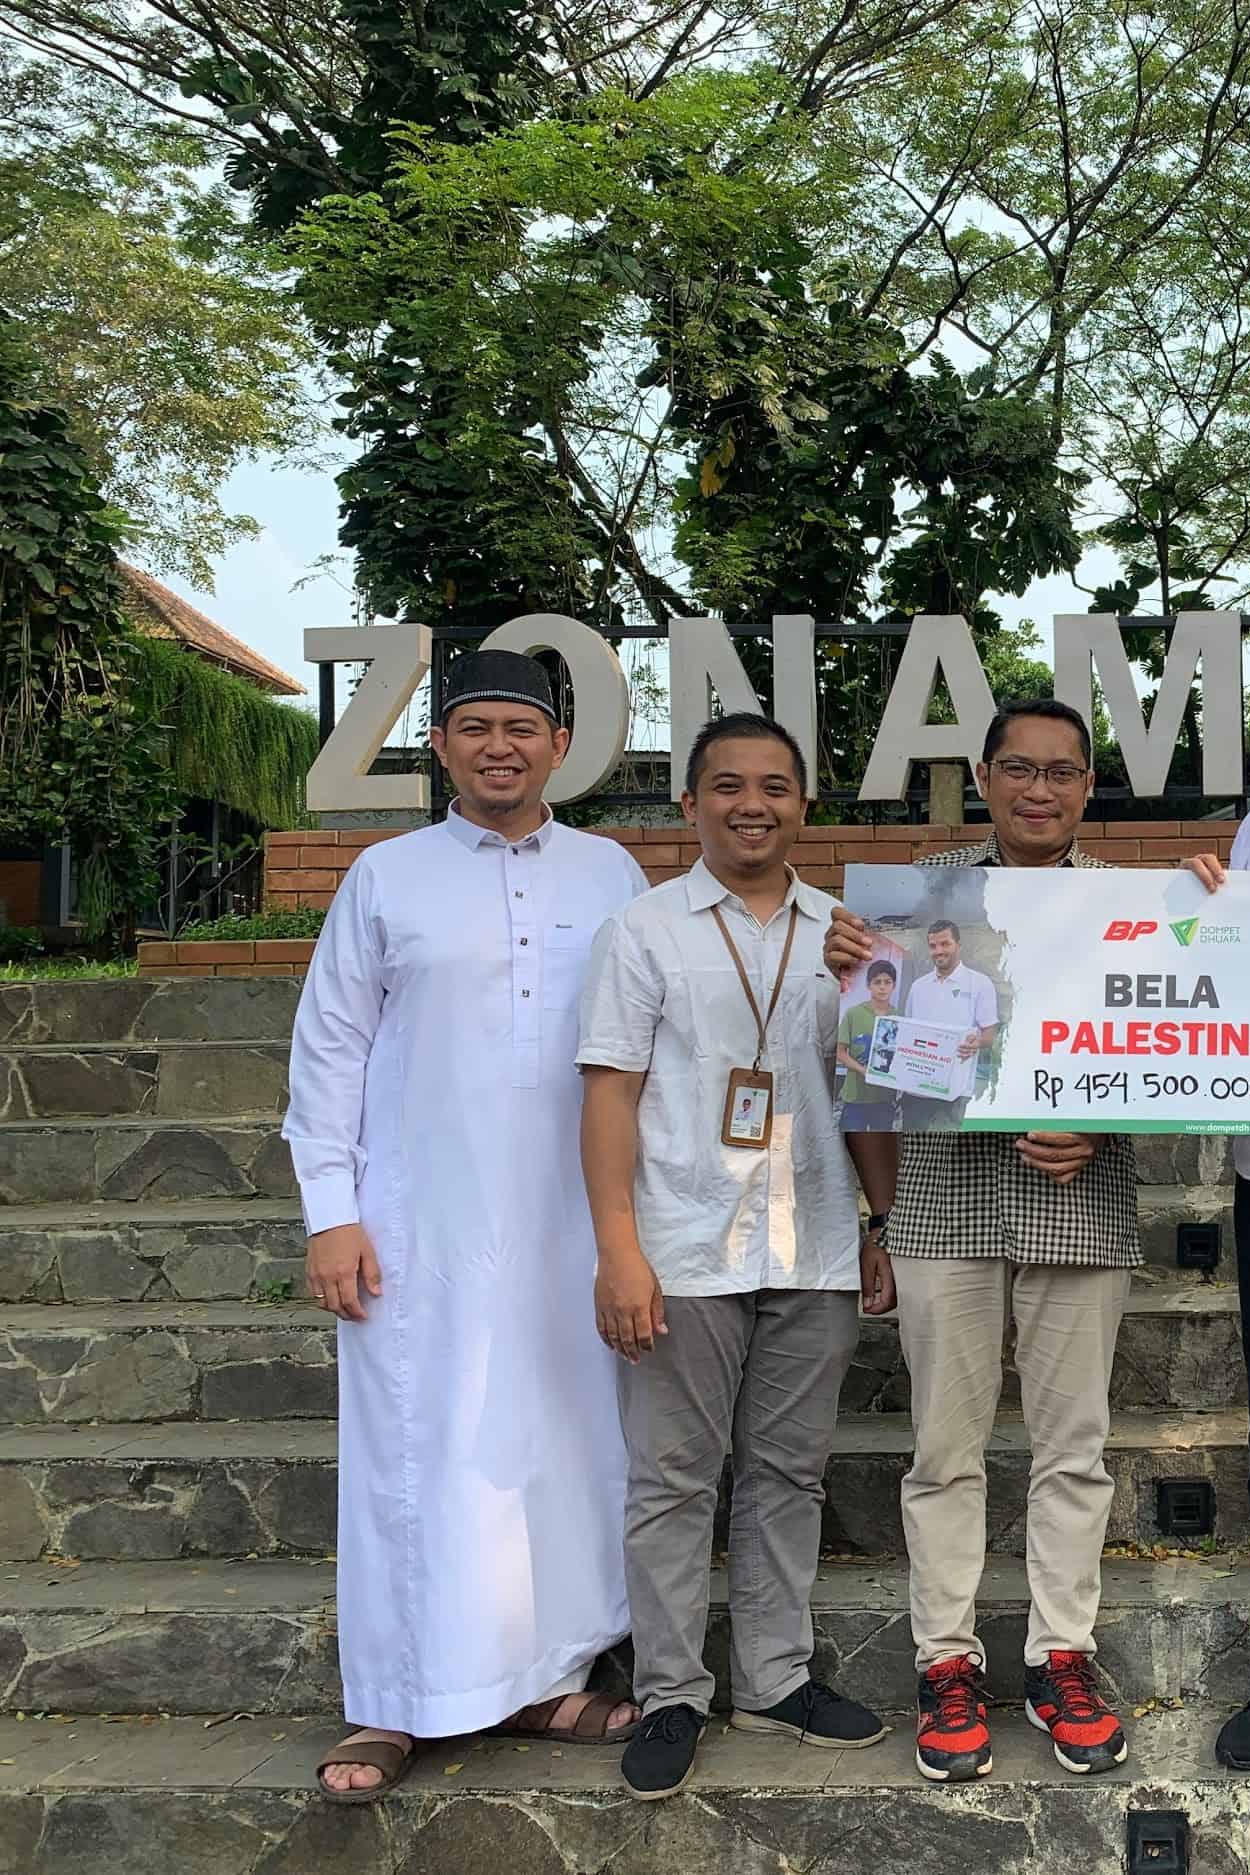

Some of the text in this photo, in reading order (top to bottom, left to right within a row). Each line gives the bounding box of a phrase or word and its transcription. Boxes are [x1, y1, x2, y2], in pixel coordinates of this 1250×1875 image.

[1102, 920, 1158, 941] BP
[1199, 925, 1241, 934] DOMPET
[1199, 934, 1241, 944] DHUAFA
[1104, 973, 1220, 1009] BELA
[1033, 1069, 1063, 1108] Rp
